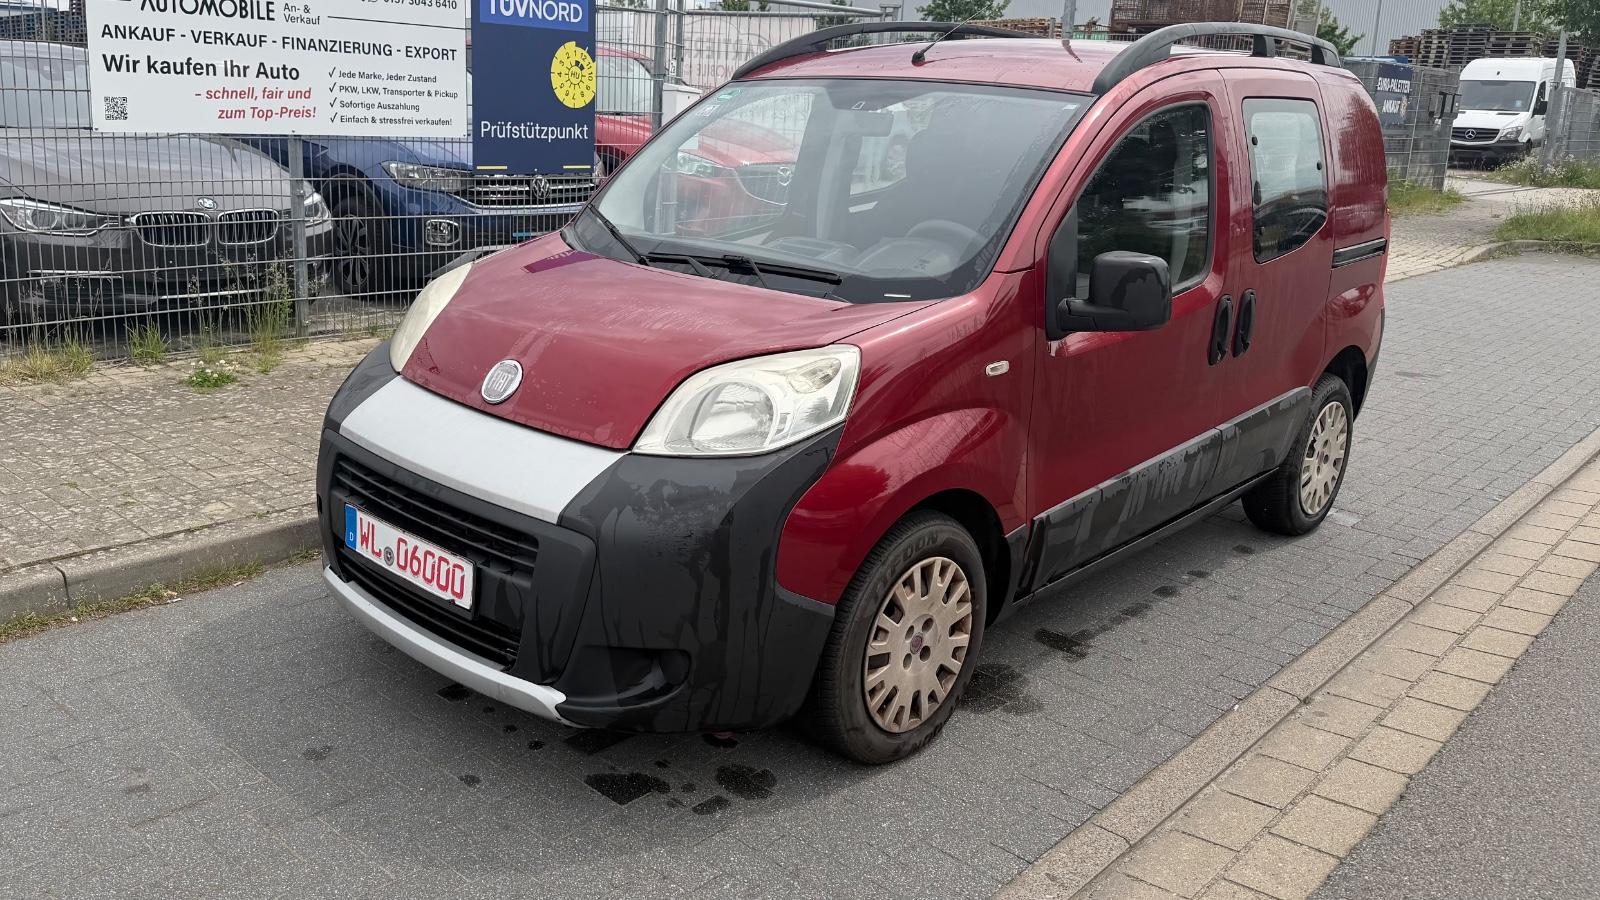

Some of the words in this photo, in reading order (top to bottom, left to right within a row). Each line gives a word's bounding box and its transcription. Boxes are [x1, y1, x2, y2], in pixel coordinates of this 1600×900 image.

[283, 3, 301, 13] An-
[303, 4, 311, 14] &
[435, 0, 458, 10] 6410
[283, 13, 321, 26] Verkauf
[101, 24, 176, 42] ANKAUF
[190, 30, 268, 48] VERKAUF
[282, 36, 393, 57] FINANZIERUNG
[405, 45, 457, 61] EXPORT
[565, 51, 570, 60] 2
[580, 52, 588, 62] 12
[102, 53, 140, 73] Wir
[147, 55, 217, 77] kaufen
[223, 59, 250, 78] Ihr
[255, 62, 300, 81] Auto
[586, 61, 592, 70] 11
[338, 70, 357, 79] Jede
[358, 71, 385, 81] Marke,
[386, 72, 406, 81] Jeder
[407, 74, 437, 83] Zustand
[570, 71, 580, 80] HU
[587, 71, 593, 82] 10
[205, 86, 258, 101] schnell,
[262, 86, 284, 100] fair
[286, 87, 312, 100] und
[339, 85, 360, 95] PKW,
[361, 86, 381, 96] LKW,
[382, 87, 425, 98] Transporter
[427, 89, 432, 97] &
[434, 90, 459, 100] Pickup
[339, 100, 376, 111] Sofortige
[377, 101, 420, 113] Auszahlung
[217, 108, 246, 120] zum
[249, 106, 317, 122] Top-Preis!
[340, 114, 369, 124] Einfach
[370, 115, 377, 124] &
[379, 116, 414, 125] stressfrei
[415, 117, 453, 126] verkaufen!
[480, 120, 589, 143] Prüfstützpunkt
[349, 531, 354, 542] D
[359, 516, 382, 558] WL
[396, 537, 466, 600] 06000
